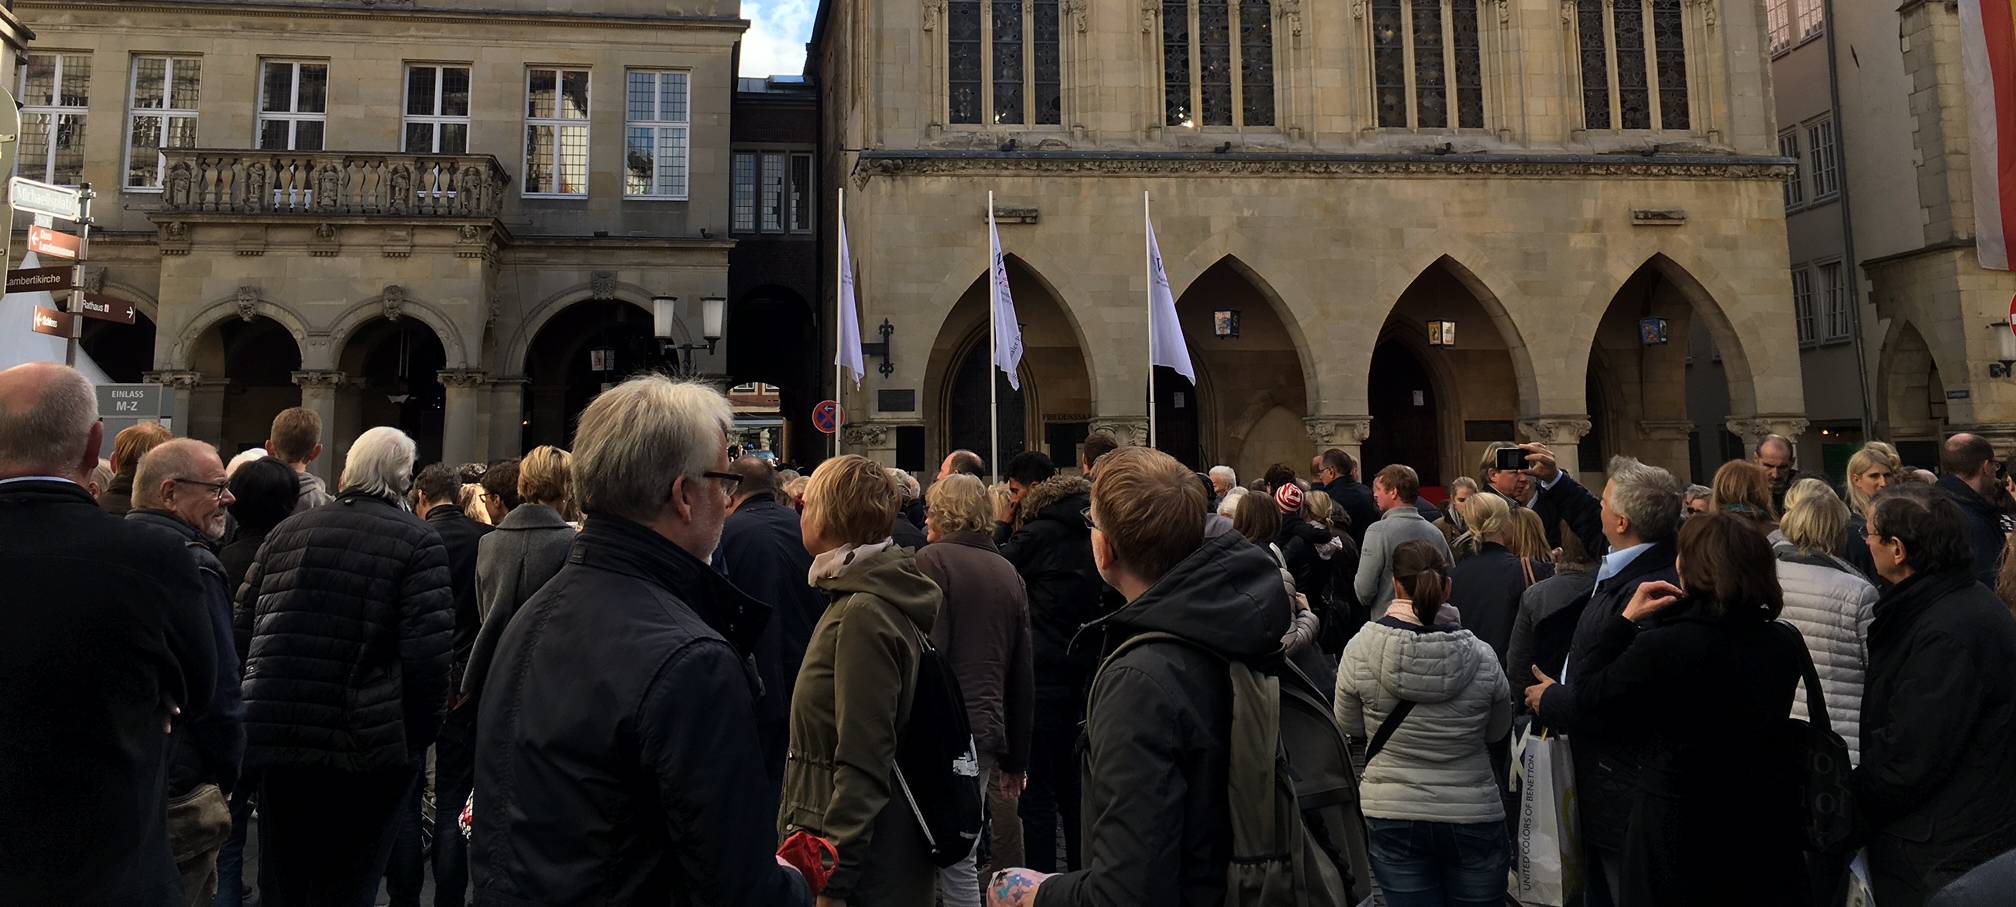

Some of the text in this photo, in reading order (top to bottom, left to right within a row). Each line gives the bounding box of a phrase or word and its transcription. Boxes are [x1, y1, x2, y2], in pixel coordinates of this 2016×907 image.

[111, 390, 144, 398] EINLASS
[116, 401, 138, 411] M-Z
[1525, 803, 1533, 817] OF
[1522, 818, 1532, 855] COLORS
[1523, 856, 1531, 891] UNITED
